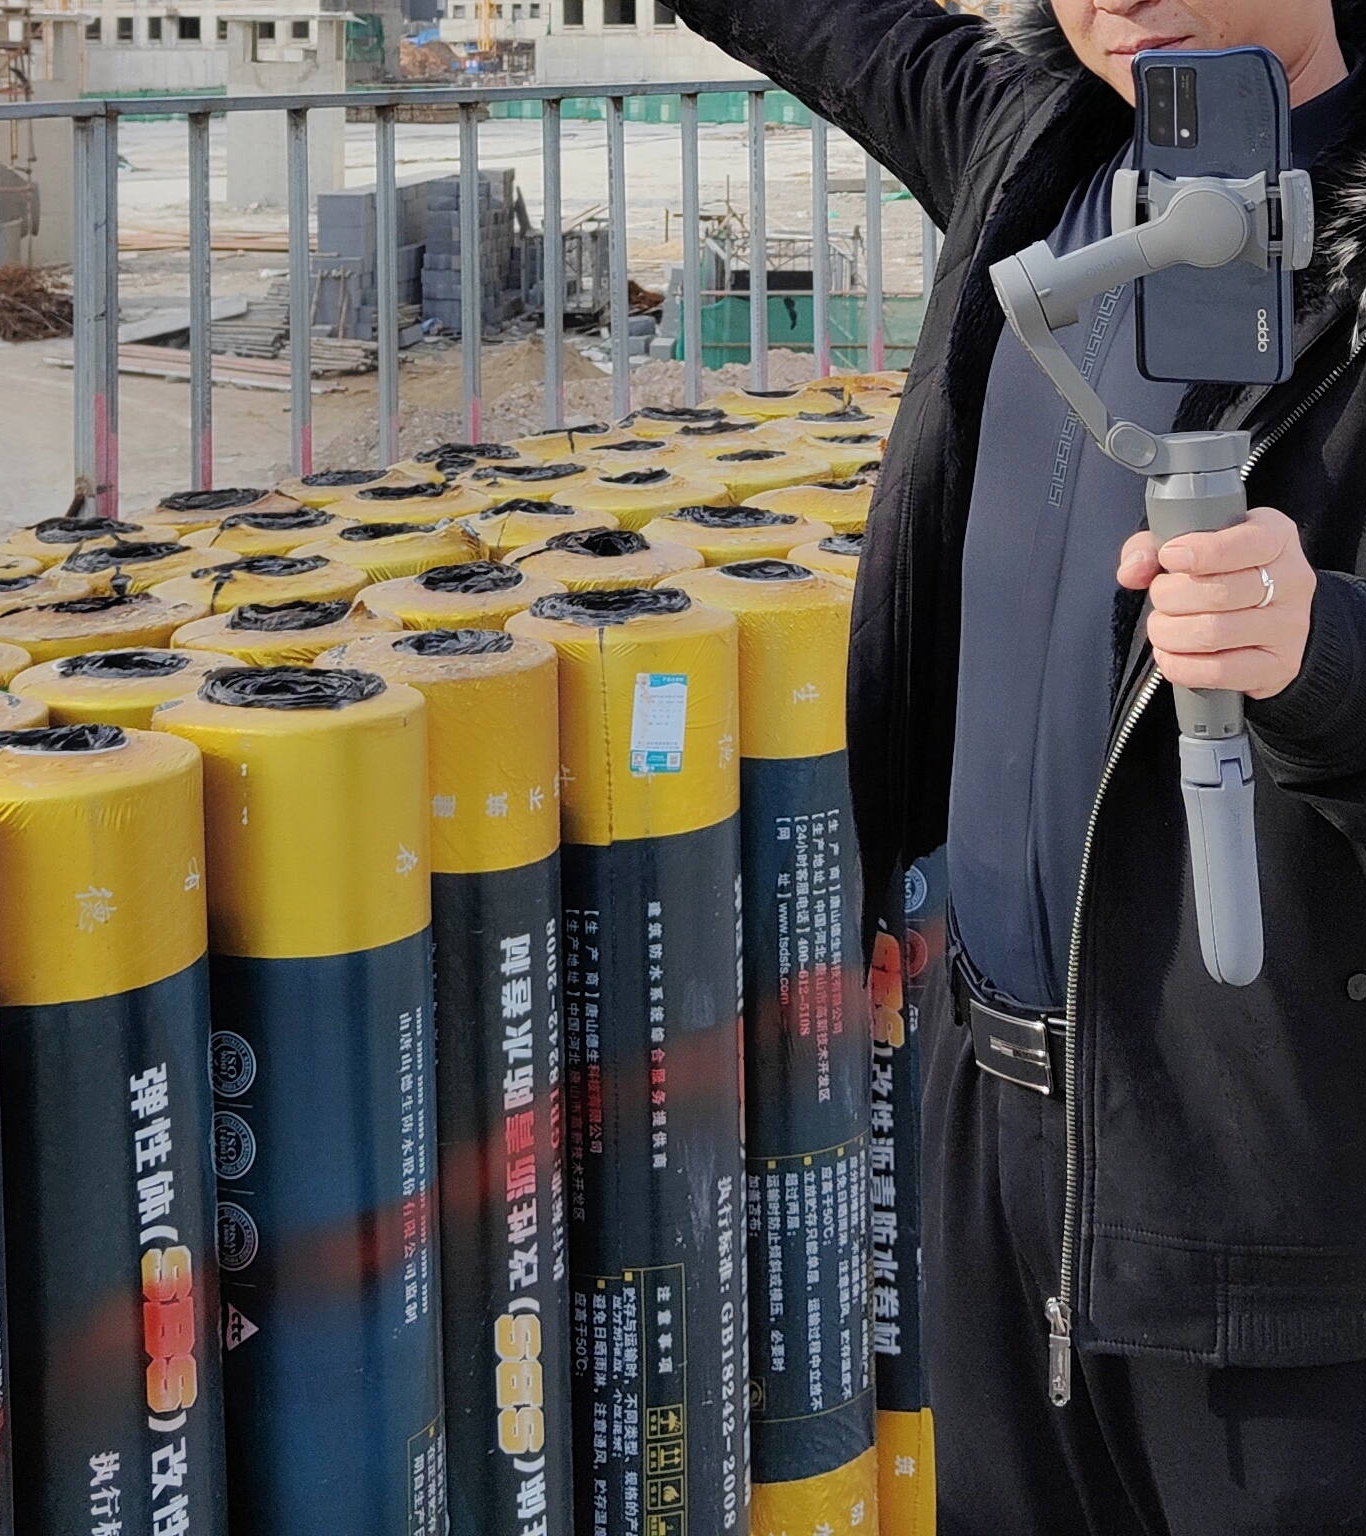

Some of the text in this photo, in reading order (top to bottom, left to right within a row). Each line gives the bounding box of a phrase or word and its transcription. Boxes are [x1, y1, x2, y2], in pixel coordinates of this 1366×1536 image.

[227, 1050, 237, 1079] ISO
[647, 900, 668, 1170] 建筑防水系统综合服务提供商
[227, 1131, 237, 1161] ISO
[656, 1285, 673, 1375] 注意事项
